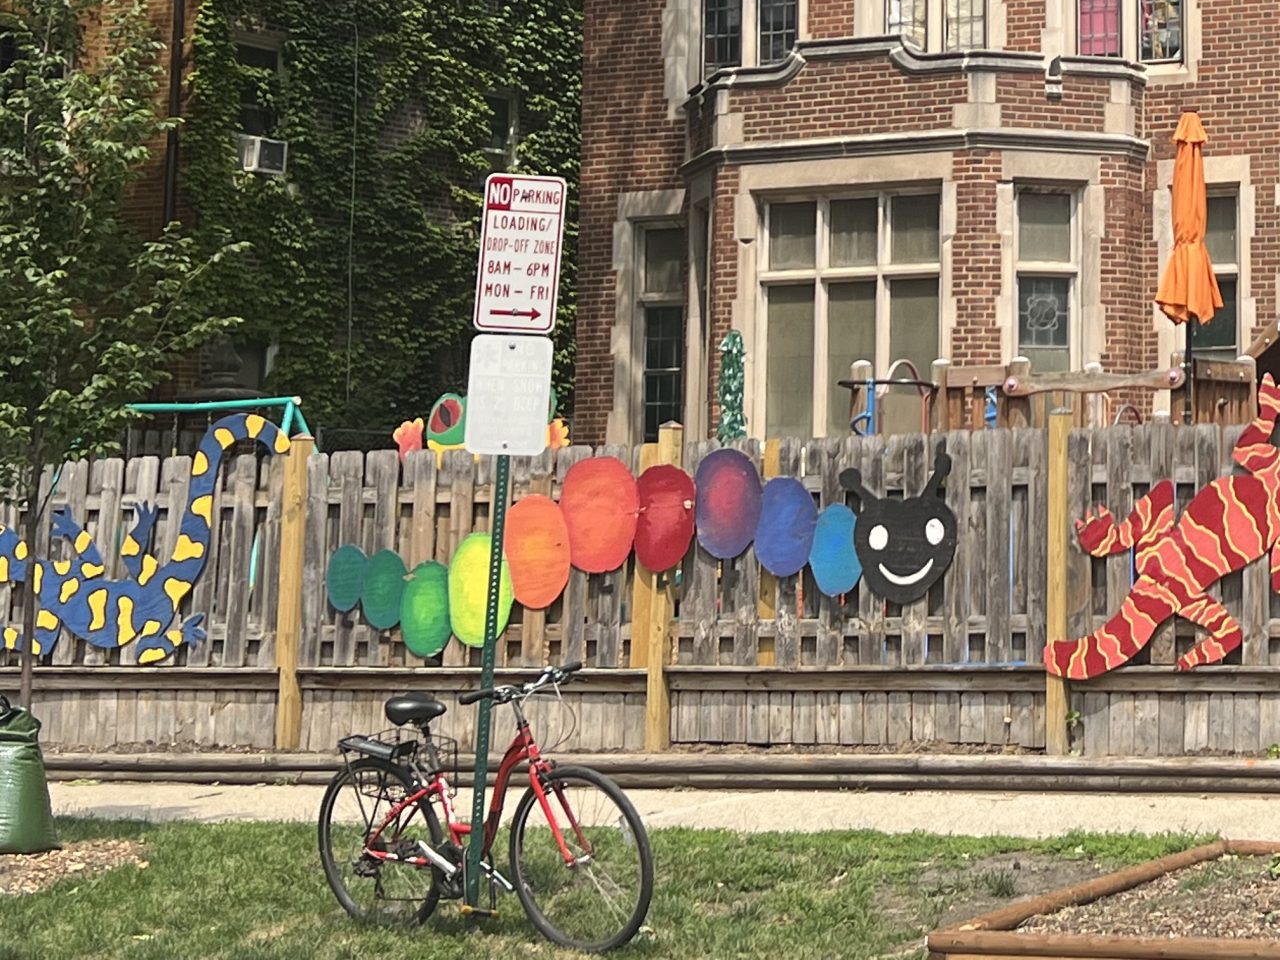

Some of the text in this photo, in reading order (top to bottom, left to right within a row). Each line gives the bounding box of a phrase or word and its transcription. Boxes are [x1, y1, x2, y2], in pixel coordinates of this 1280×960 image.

[488, 183, 560, 205] NO PARKING
[493, 215, 553, 232] LOADING/
[486, 237, 555, 255] DROP-OFF ZONE
[487, 260, 511, 275] 8AM
[526, 262, 550, 277] 6PM
[485, 283, 511, 298] MON
[530, 285, 549, 301] FRI
